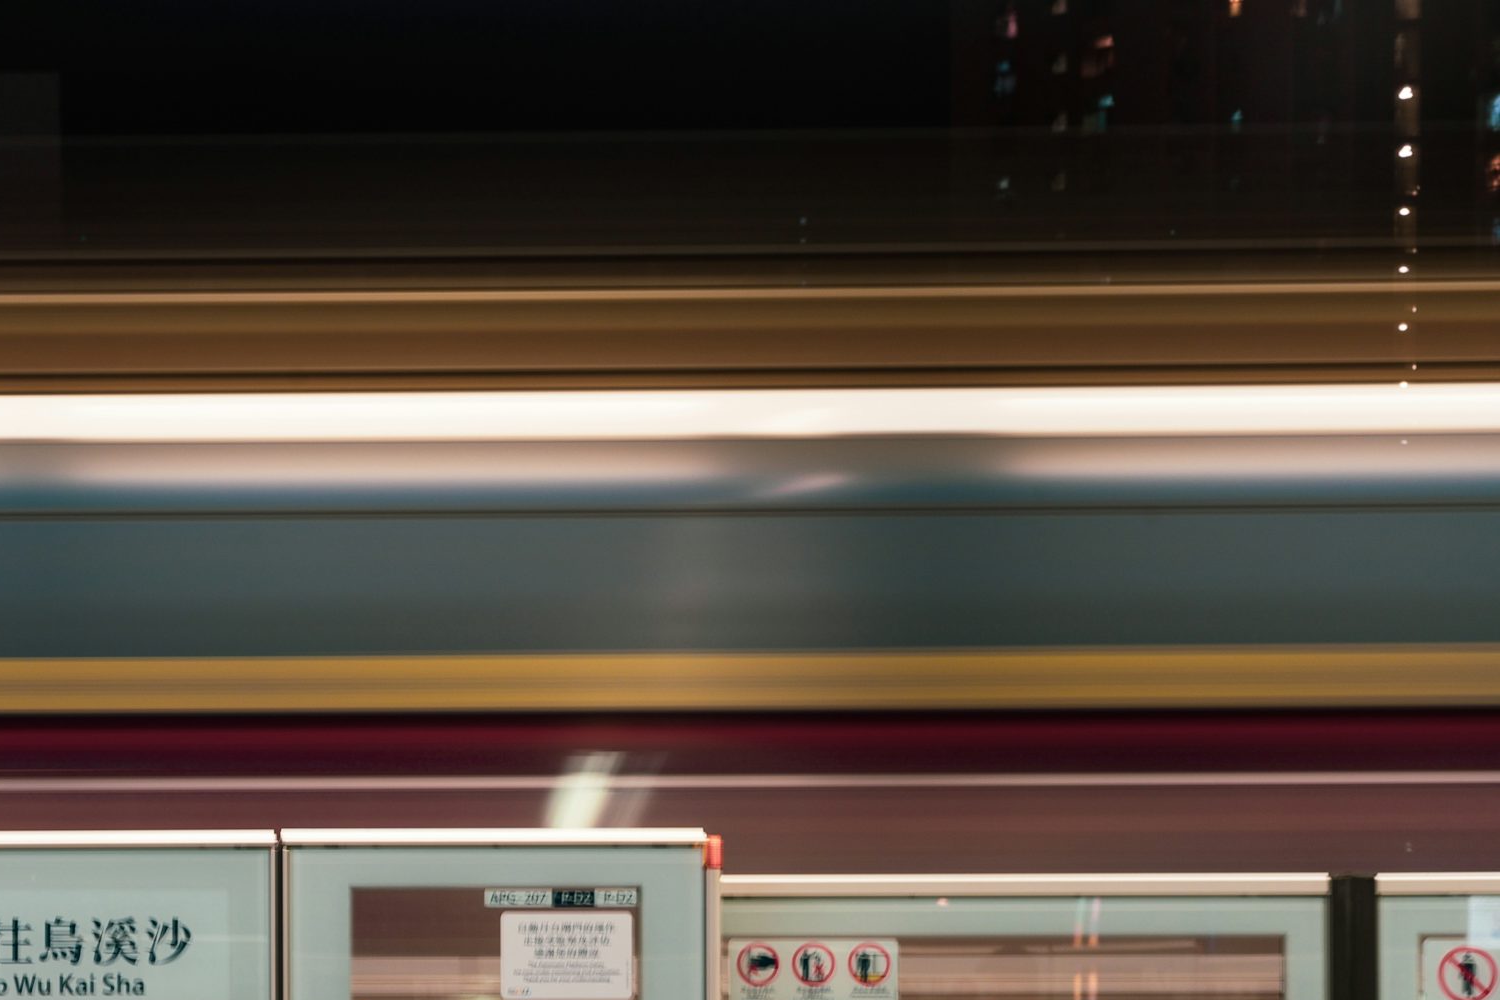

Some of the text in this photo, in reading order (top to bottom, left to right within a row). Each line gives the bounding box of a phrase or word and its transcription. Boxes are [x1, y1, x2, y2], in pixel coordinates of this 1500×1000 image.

[13, 973, 52, 997] Wu
[59, 972, 95, 997] Kai
[102, 972, 145, 997] Sha
